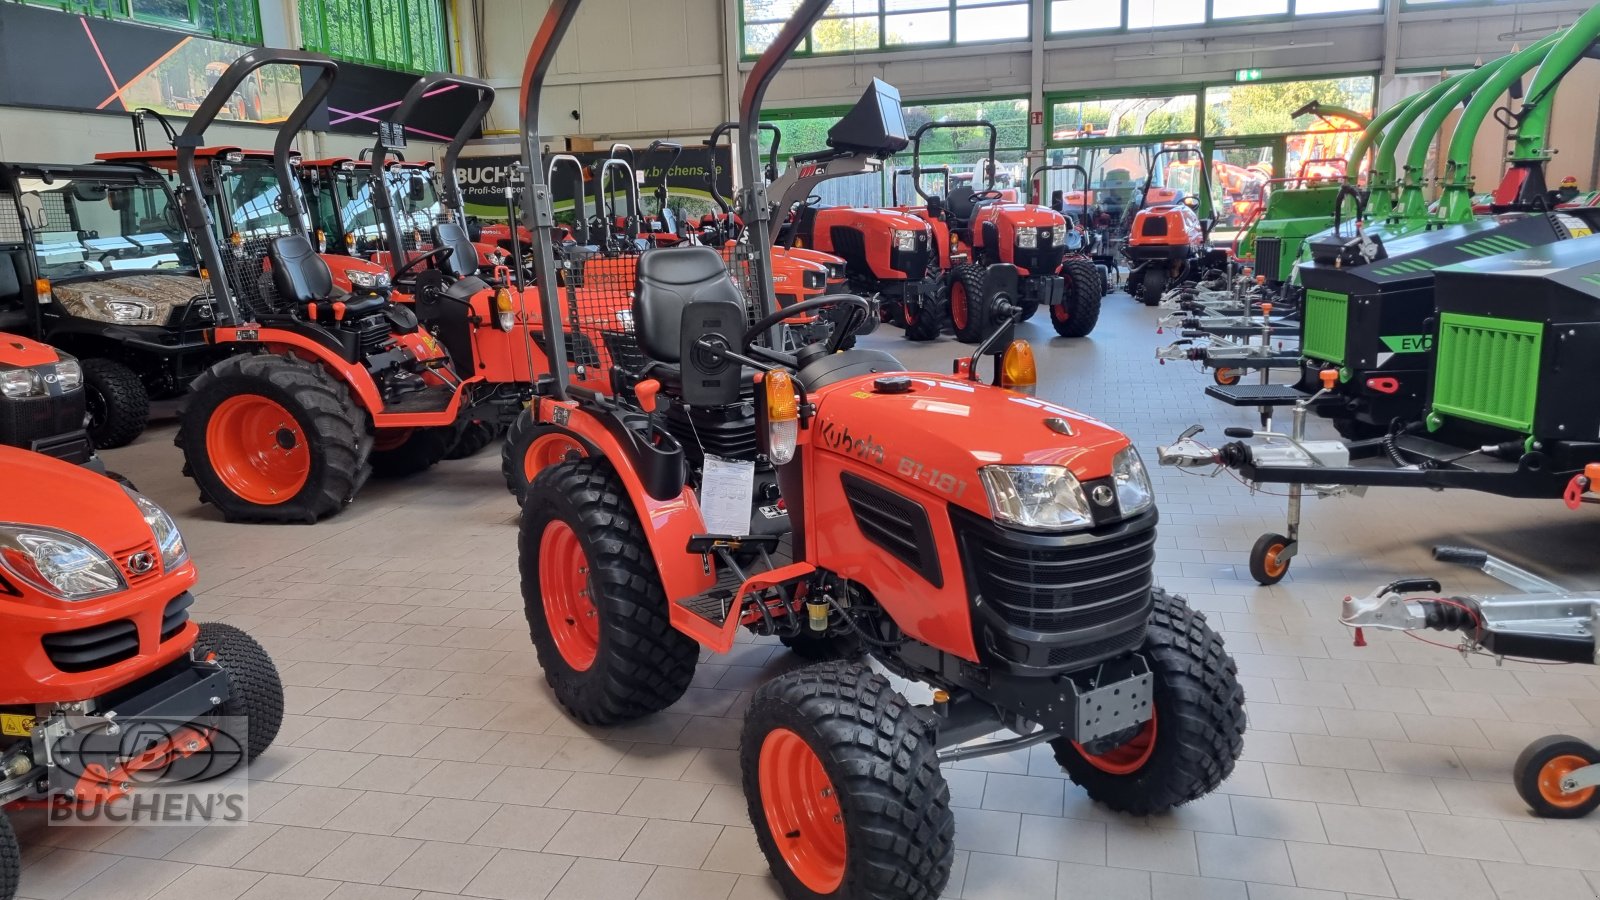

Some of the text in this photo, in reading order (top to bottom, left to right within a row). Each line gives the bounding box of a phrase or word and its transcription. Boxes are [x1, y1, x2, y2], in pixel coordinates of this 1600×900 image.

[1401, 337, 1433, 350] EVO
[820, 420, 967, 498] Kubota B1-181
